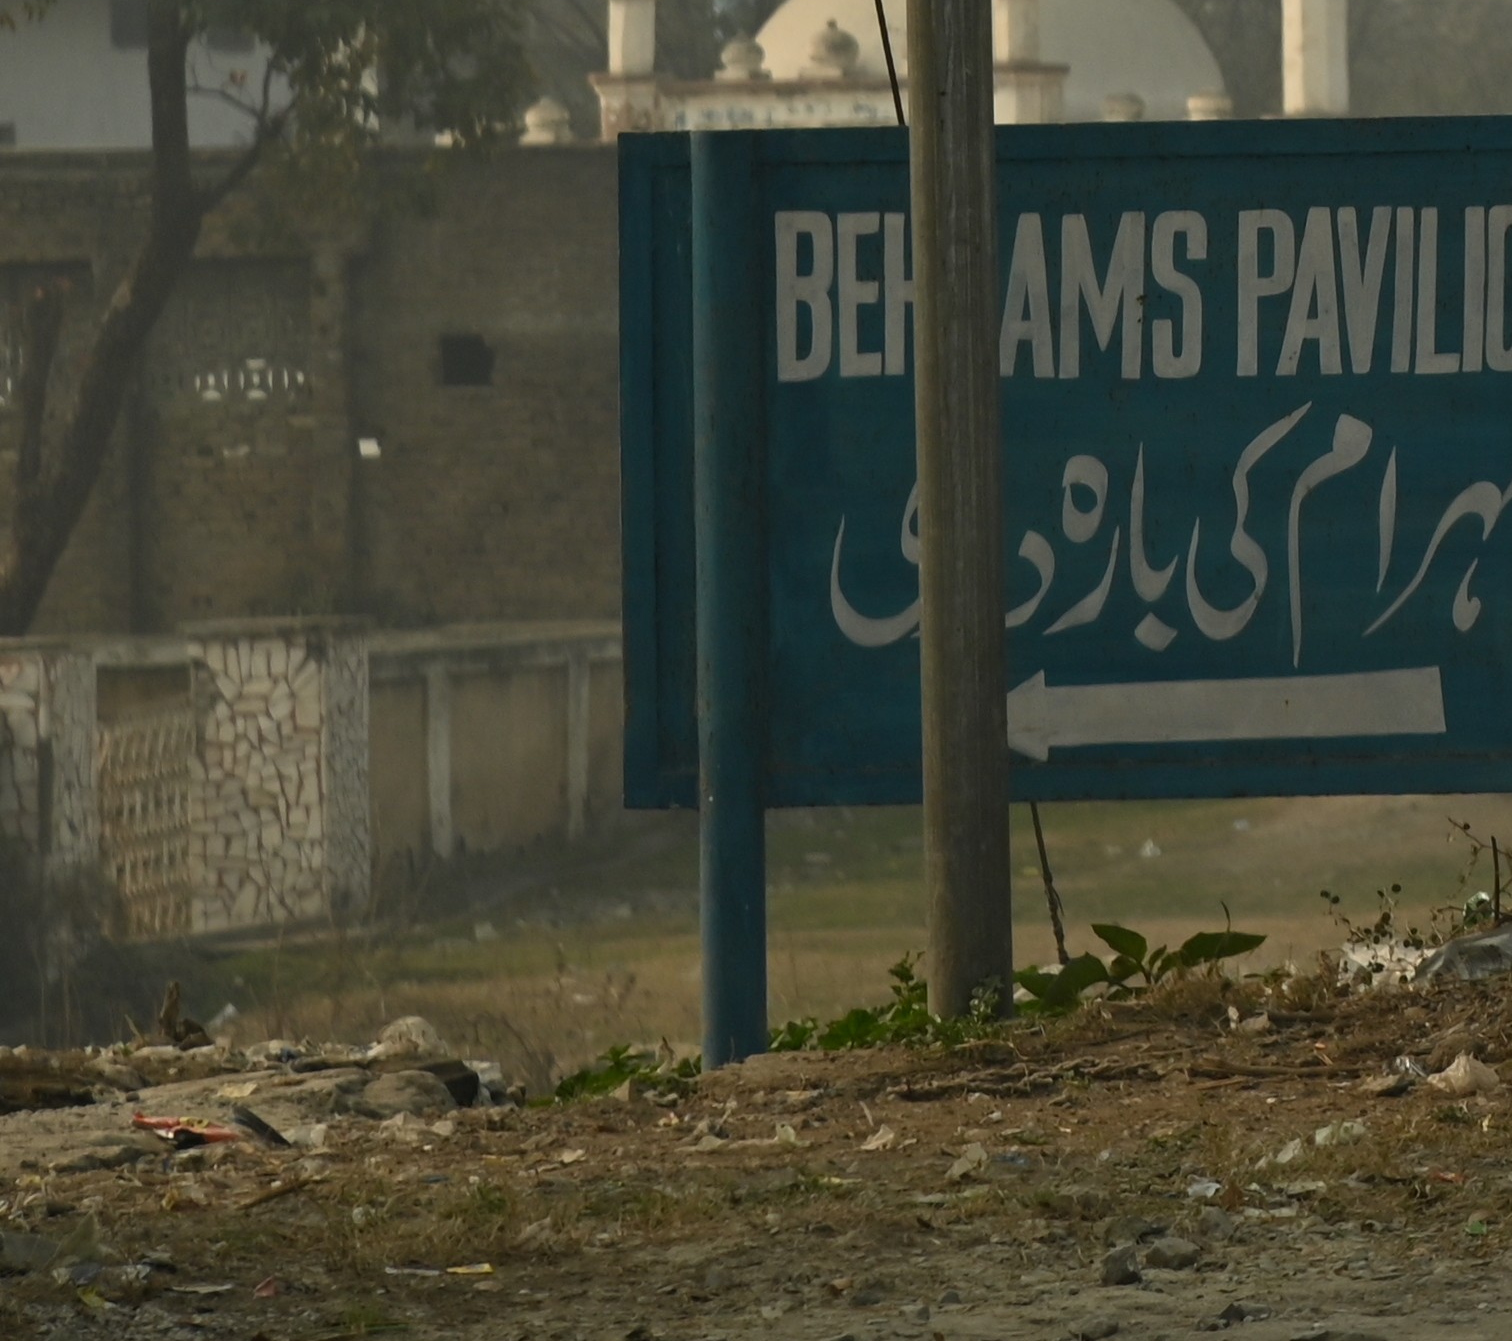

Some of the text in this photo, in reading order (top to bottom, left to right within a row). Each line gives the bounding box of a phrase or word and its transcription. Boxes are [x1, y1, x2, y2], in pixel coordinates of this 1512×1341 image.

[774, 210, 1208, 382] BEHAMS
[830, 483, 1056, 647] دی
[1185, 400, 1313, 642] کی
